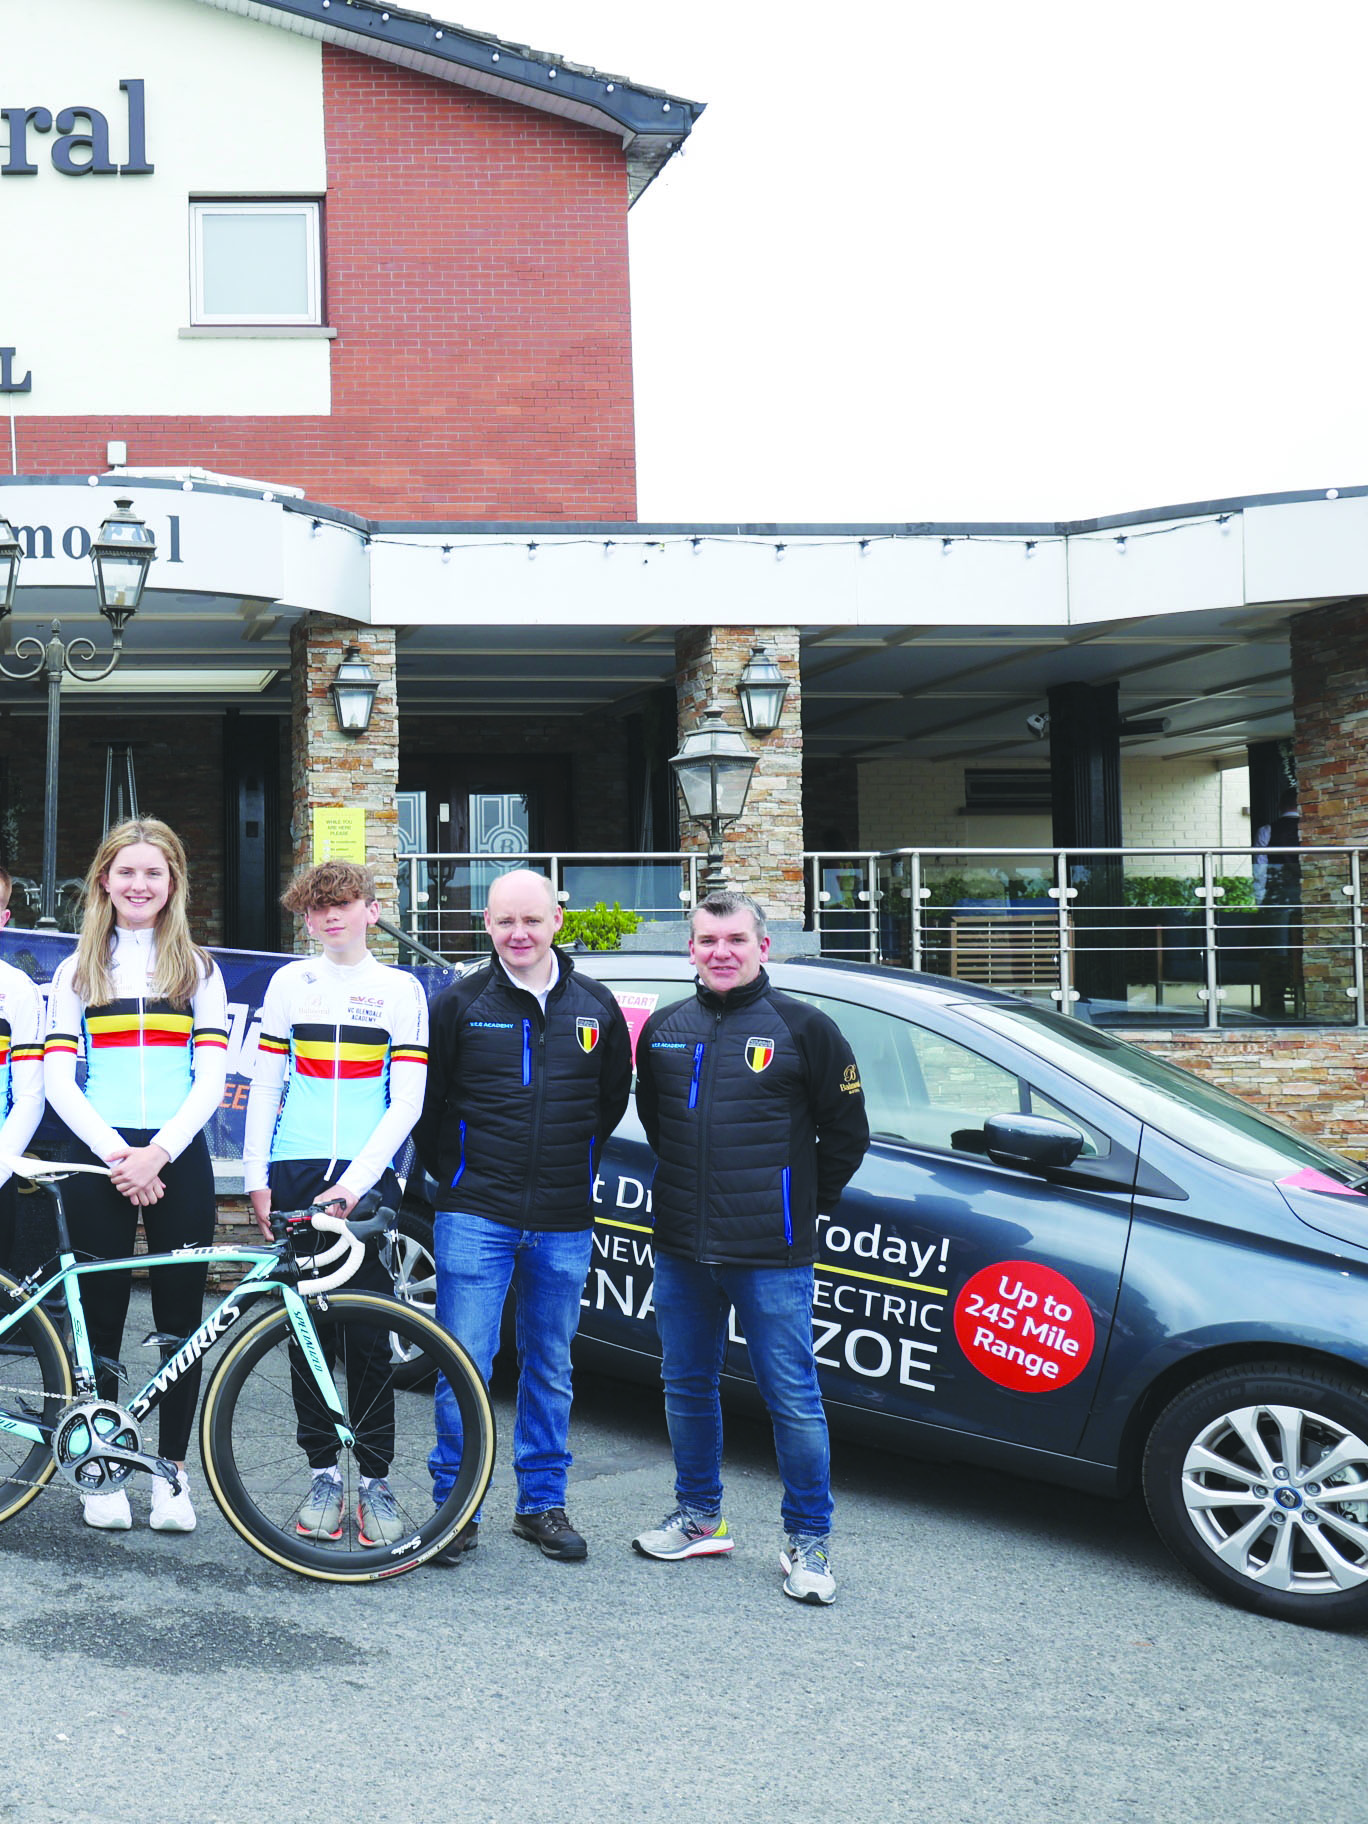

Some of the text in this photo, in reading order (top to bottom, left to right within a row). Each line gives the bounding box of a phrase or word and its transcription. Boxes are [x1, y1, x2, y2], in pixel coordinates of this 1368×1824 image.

[812, 1279, 944, 1333] ECTRIC
[964, 1293, 1080, 1358] 245 Mile
[998, 1275, 1073, 1323] Up to
[132, 1304, 240, 1419] S-WORKS
[810, 1317, 938, 1392] ZOE
[972, 1326, 1060, 1380] Range
